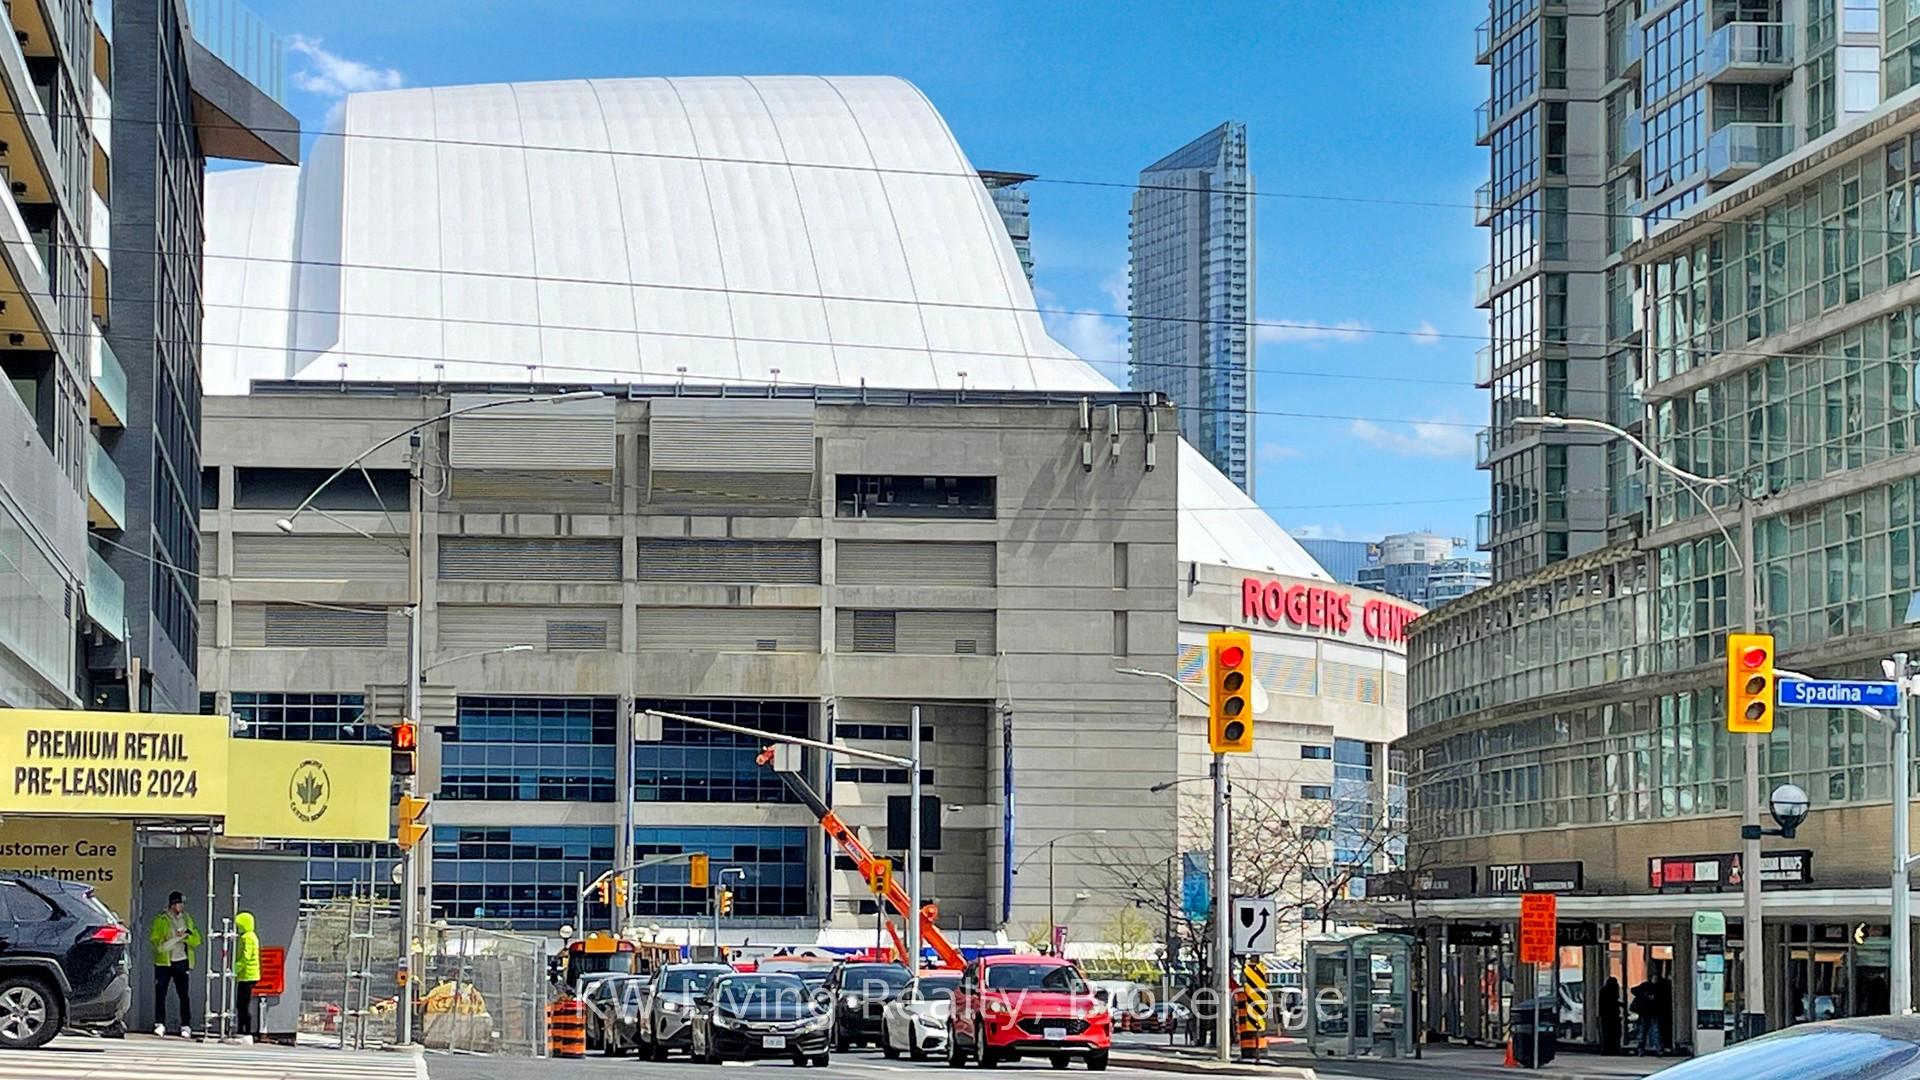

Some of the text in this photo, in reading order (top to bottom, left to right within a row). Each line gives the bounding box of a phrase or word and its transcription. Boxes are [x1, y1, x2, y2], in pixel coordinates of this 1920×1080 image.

[1242, 578, 1353, 632] ROGERS
[1795, 683, 1862, 703] Spadina
[26, 729, 189, 762] PREMIUM RETAIL
[14, 766, 198, 799] PRE-LEASING 2024
[0, 840, 117, 857] ustomer Care
